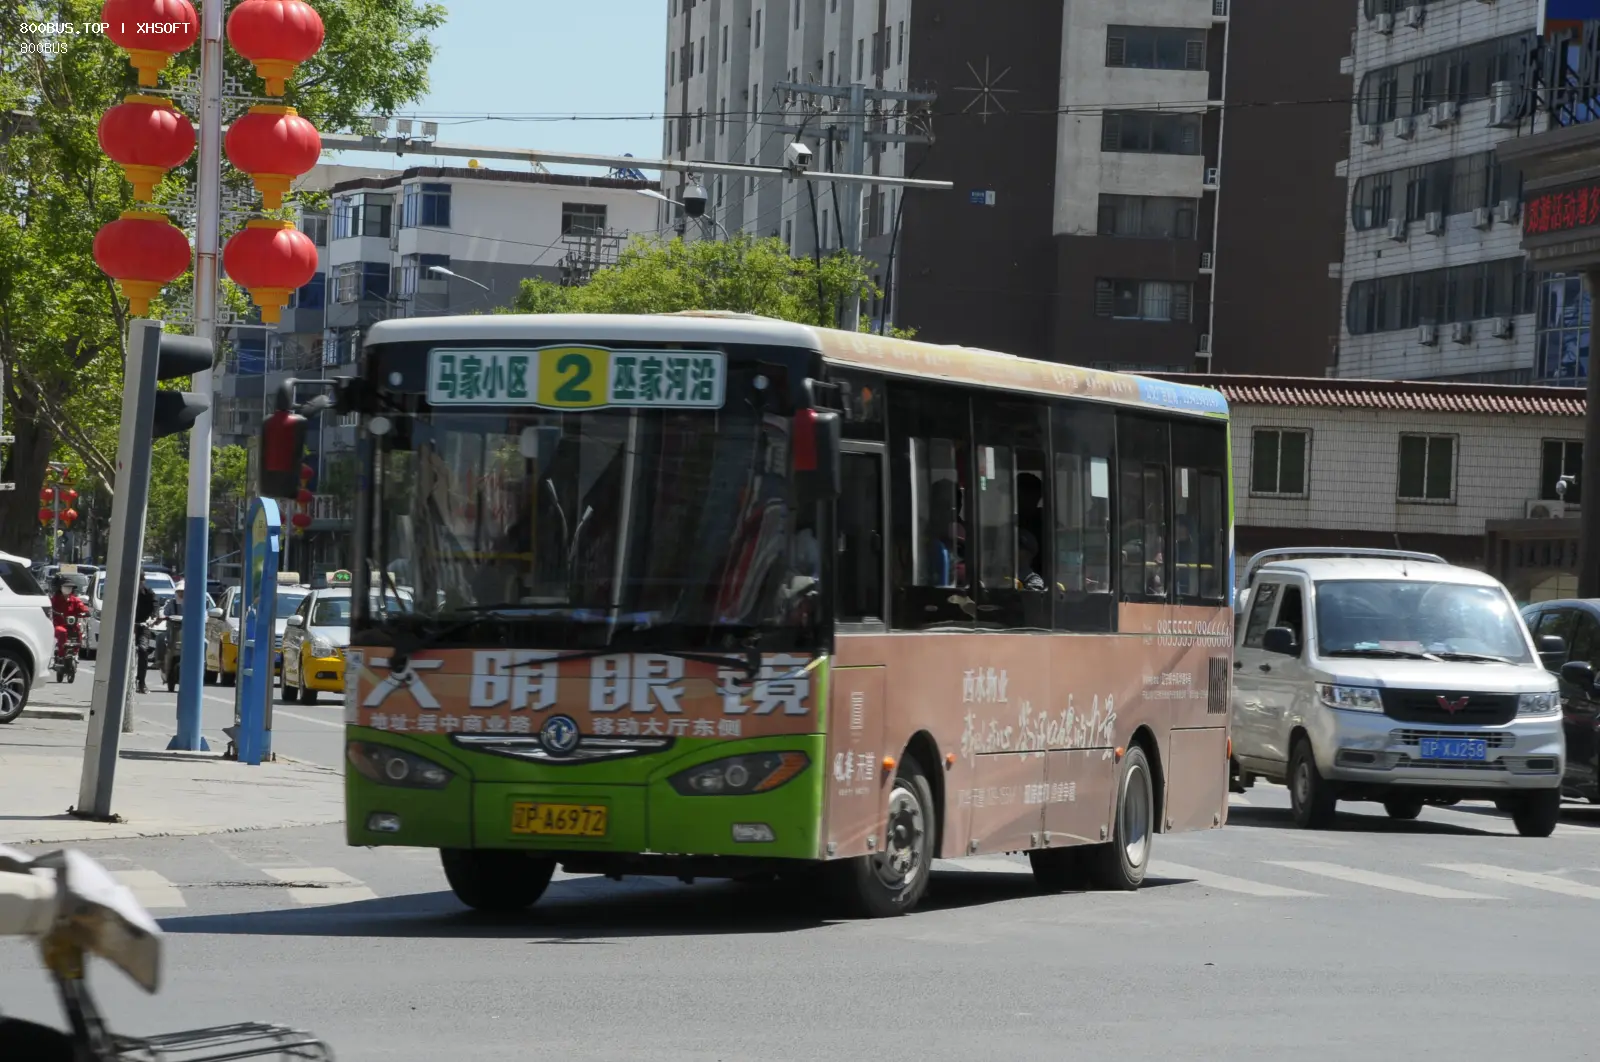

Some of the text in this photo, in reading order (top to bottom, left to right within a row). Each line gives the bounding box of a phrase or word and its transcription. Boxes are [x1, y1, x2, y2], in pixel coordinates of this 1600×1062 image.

[437, 354, 529, 399] 马家小区
[554, 353, 593, 402] 2
[363, 650, 810, 715] 大明眼镜
[592, 717, 743, 737] 移动大厅东侧
